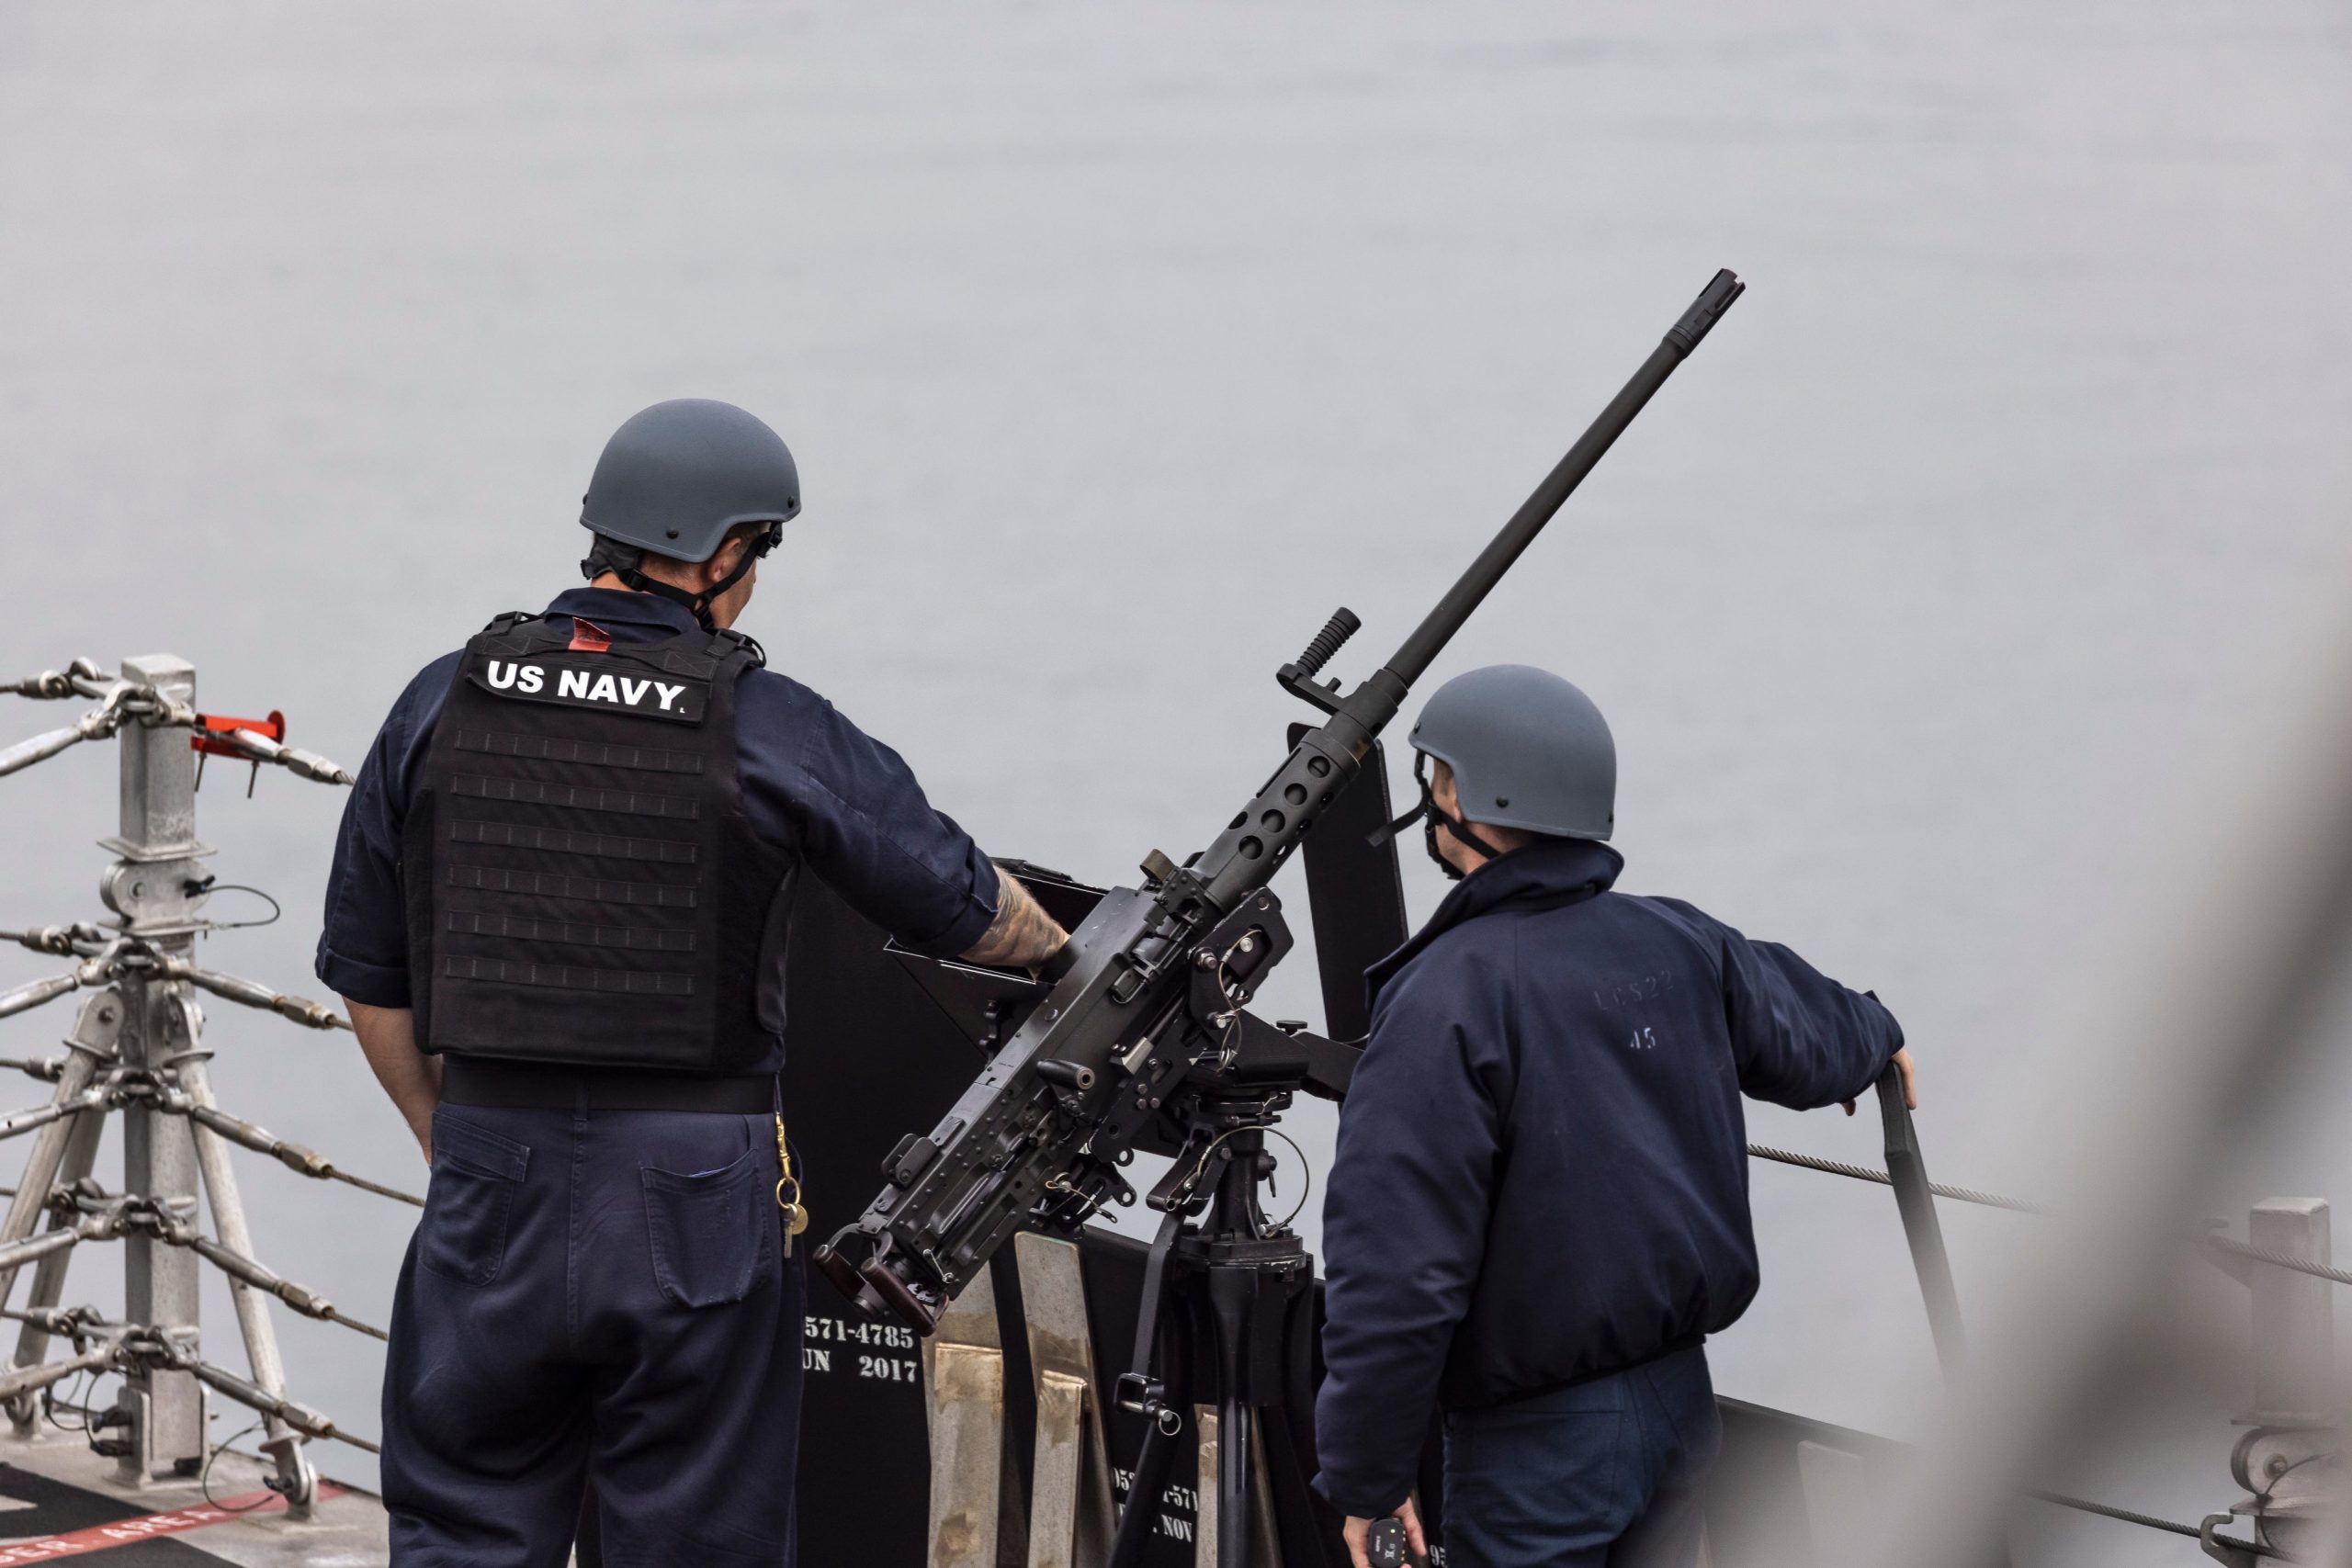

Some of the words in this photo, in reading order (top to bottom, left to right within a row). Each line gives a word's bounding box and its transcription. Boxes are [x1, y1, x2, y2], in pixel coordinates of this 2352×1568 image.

[487, 660, 545, 694] US
[804, 1315, 914, 1348] 571-4785
[858, 1355, 918, 1382] 2017
[101, 1510, 227, 1540] AREA
[1160, 1514, 1193, 1543] NOV
